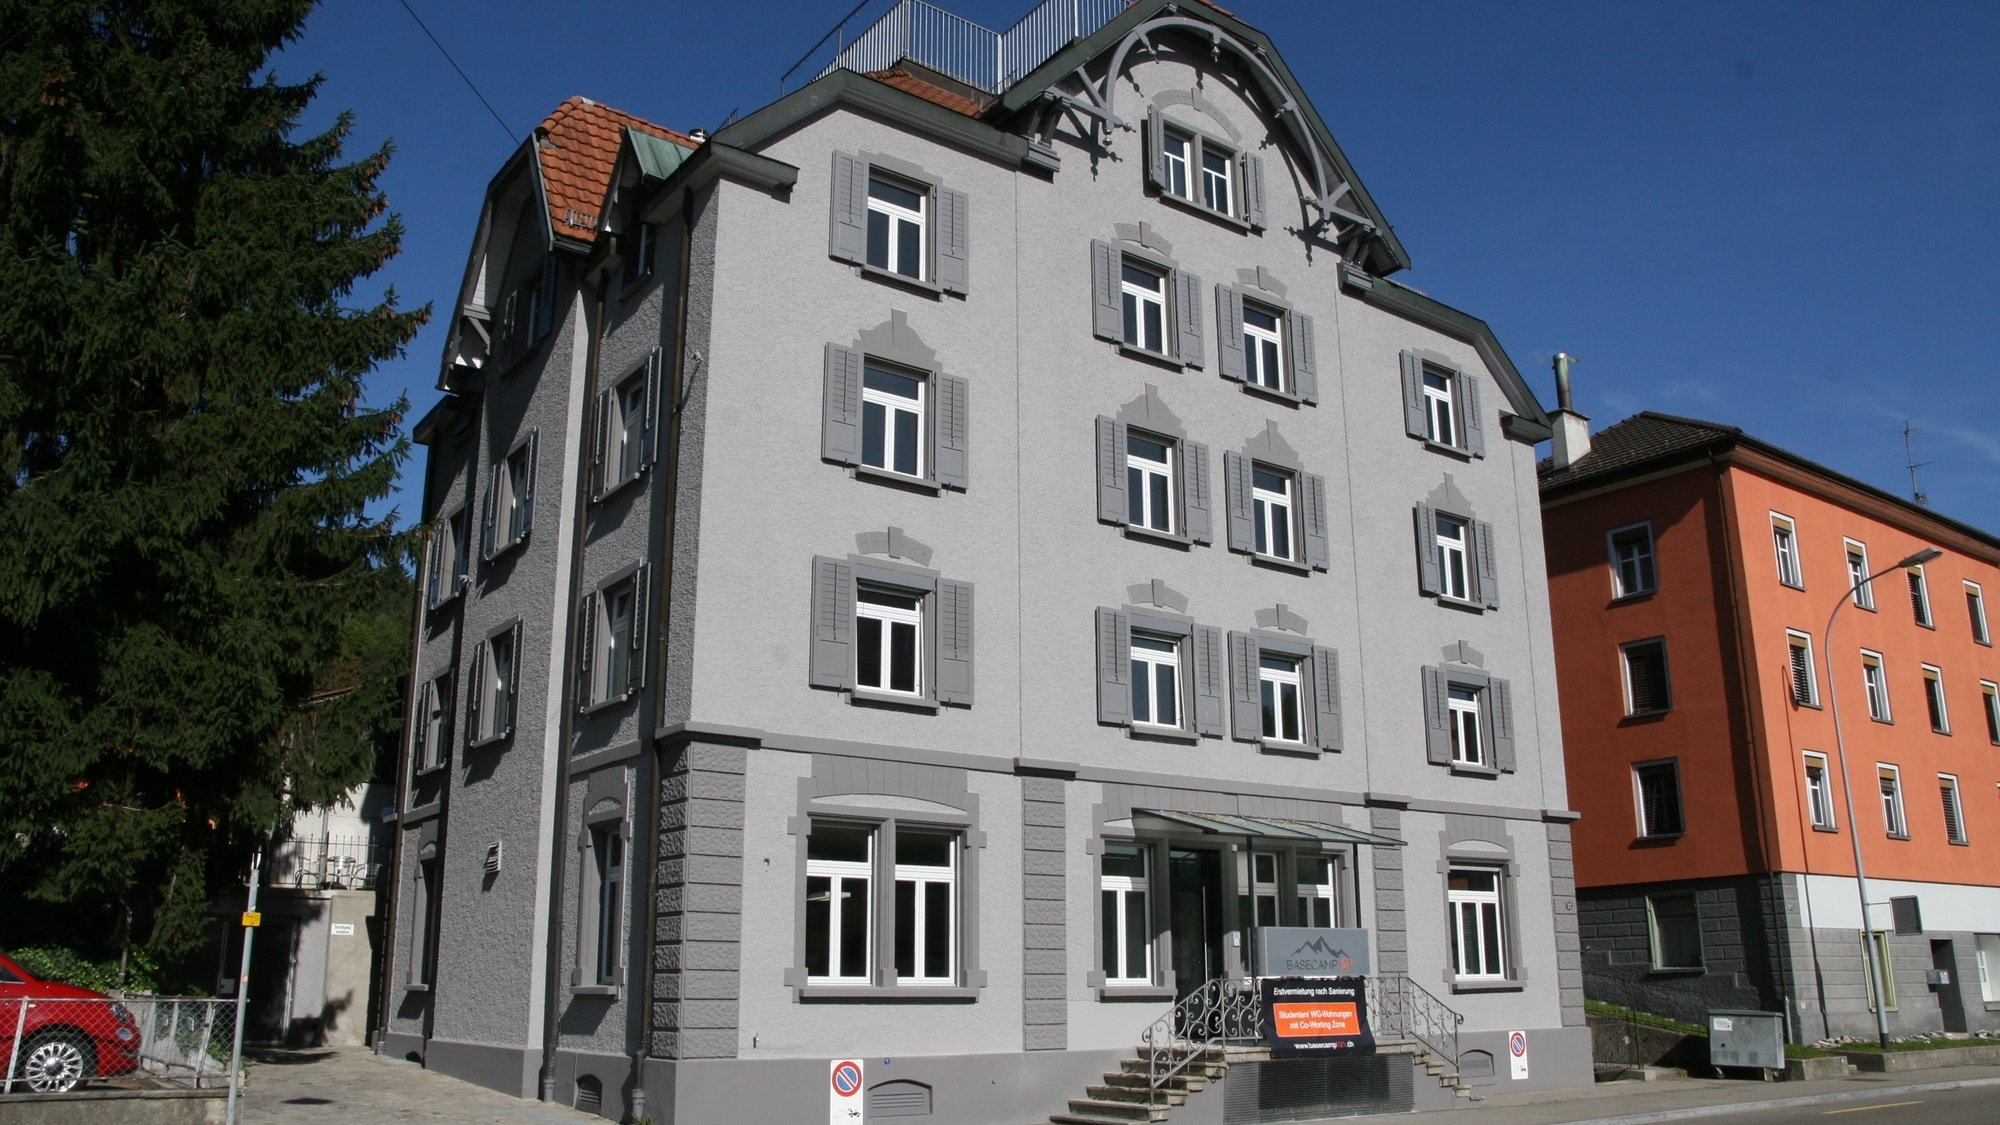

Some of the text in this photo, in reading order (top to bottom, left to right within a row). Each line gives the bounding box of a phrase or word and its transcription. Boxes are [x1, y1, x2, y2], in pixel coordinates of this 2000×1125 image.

[1273, 987, 1315, 996] Erstvermietung
[1328, 987, 1354, 996] Sanierung
[1278, 1010, 1352, 1019] Studenten/ WG-Wohnungen
[1289, 1021, 1345, 1030] mit Co-Working Zone
